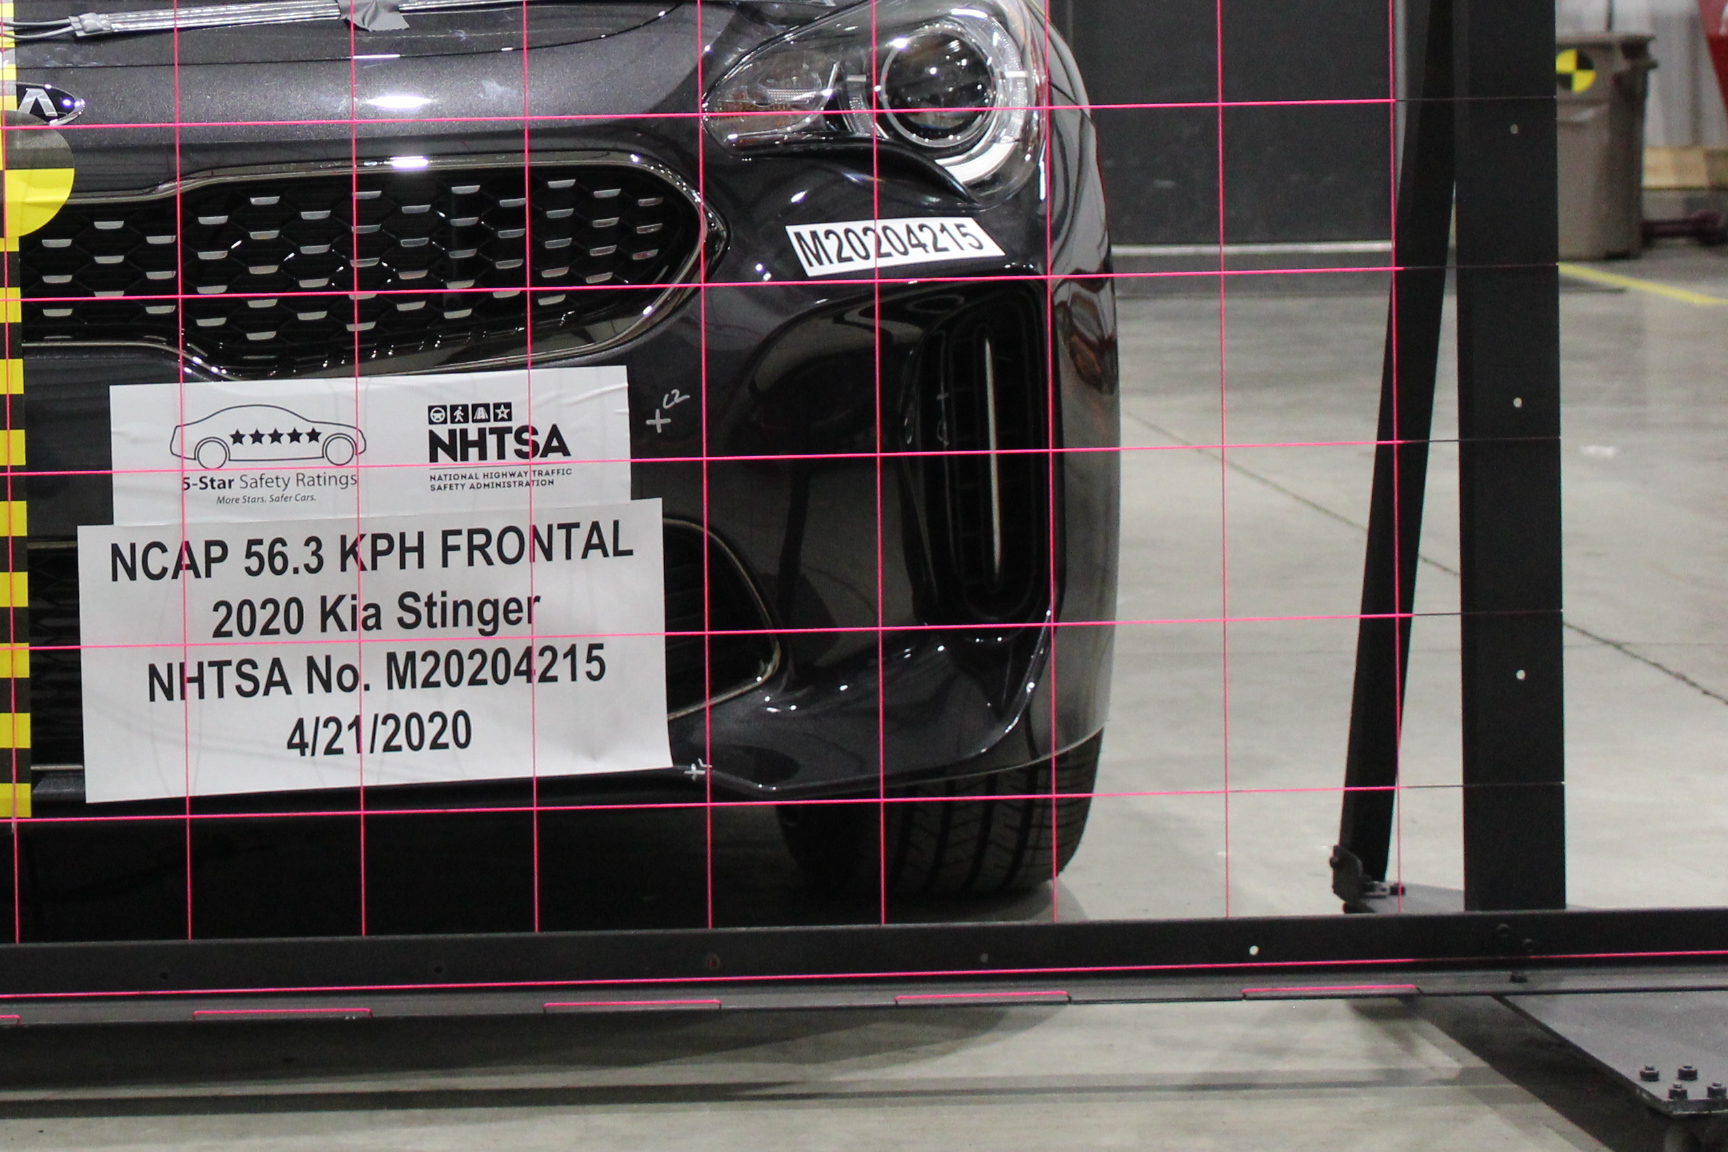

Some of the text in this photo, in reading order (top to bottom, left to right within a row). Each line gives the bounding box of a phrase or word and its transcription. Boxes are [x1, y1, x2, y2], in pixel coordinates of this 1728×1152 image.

[793, 222, 984, 268] M20204215
[428, 424, 571, 463] NHTSA
[182, 472, 358, 491] 5-Star Safety Ratings
[429, 468, 573, 482] NATIONAL HIGHWAY TRAFFIC
[430, 479, 555, 492] SAFETY ADMINISTRATION
[216, 493, 317, 505] More Stars. Safer Cars.
[110, 519, 634, 582] NCAP 56.3 KPH FRONTAL
[212, 590, 541, 638] 2020 Kia Stinger
[148, 643, 606, 702] NHTSA No. M20204215
[287, 710, 472, 757] 4/21/2020
